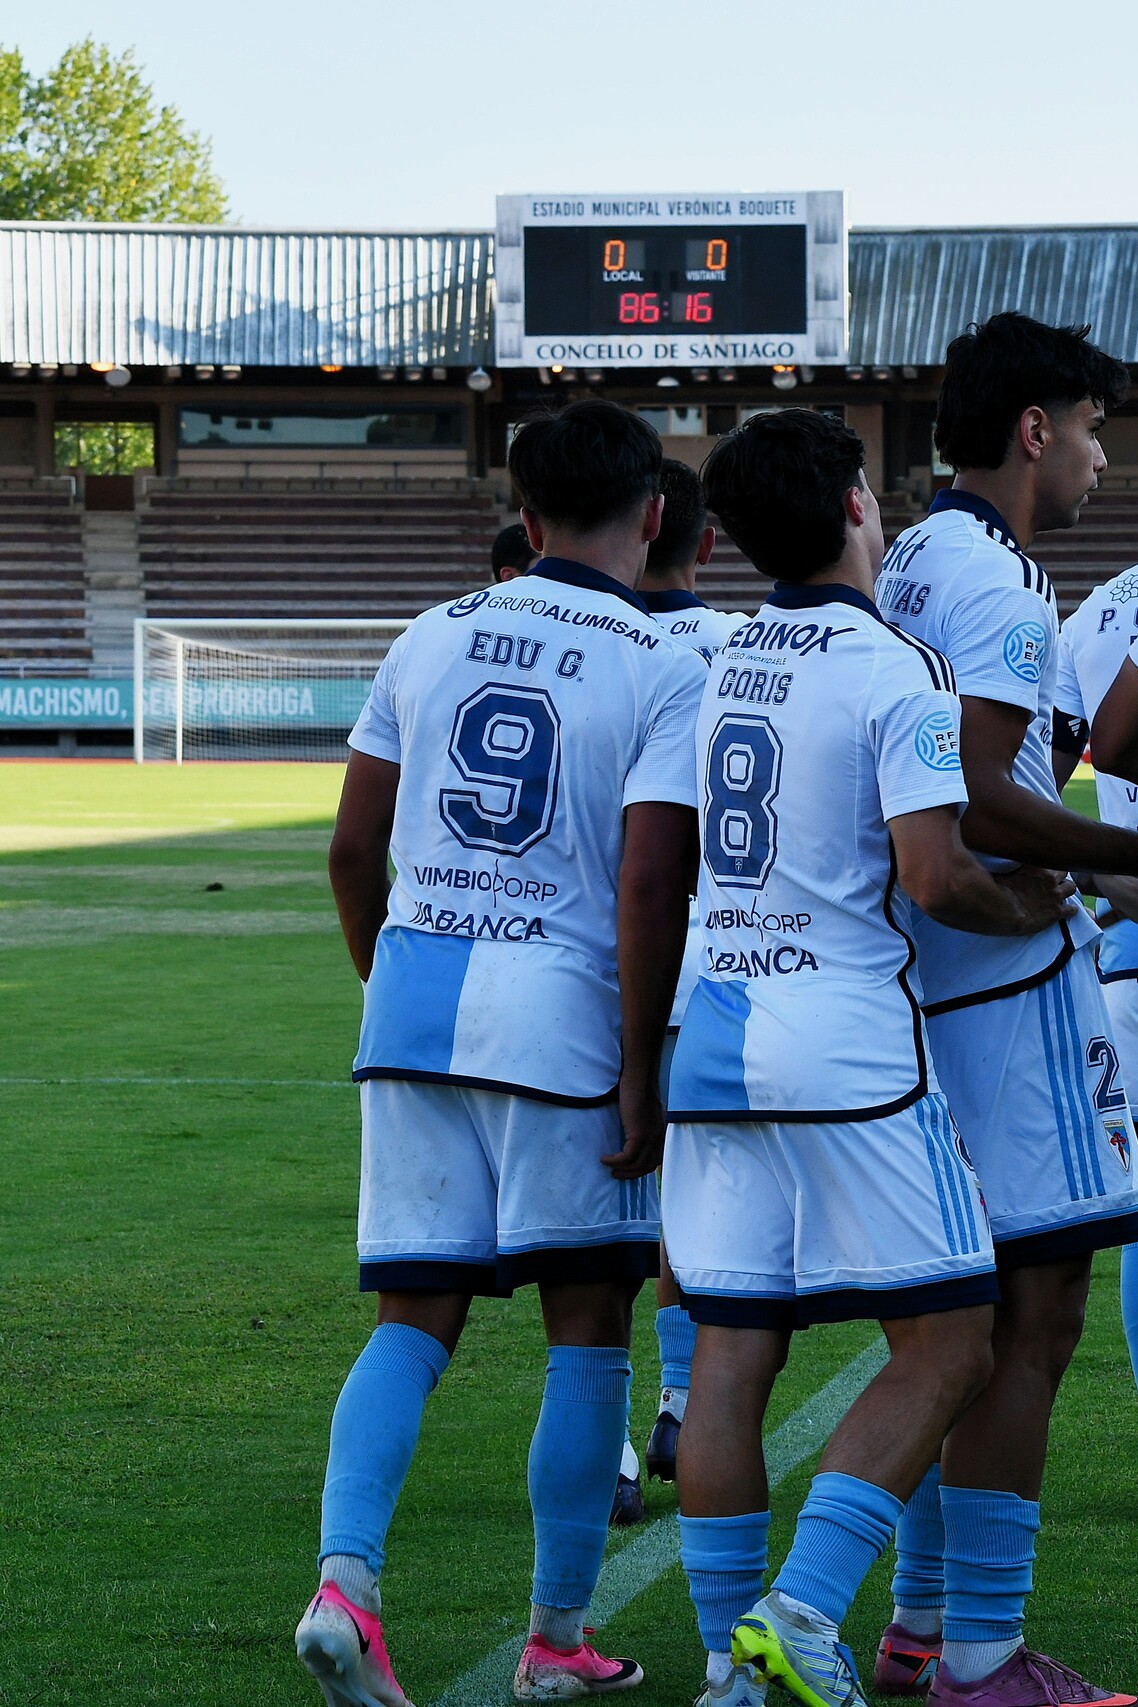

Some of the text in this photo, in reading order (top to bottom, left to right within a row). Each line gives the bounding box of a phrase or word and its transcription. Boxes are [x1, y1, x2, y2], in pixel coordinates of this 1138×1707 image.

[533, 198, 796, 217] ESTADIO MUNICIPAL VERÓNICA BOQUETE
[604, 239, 625, 271] 0
[706, 239, 727, 271] 0
[603, 270, 643, 281] LOCAL
[685, 270, 726, 281] VISITANTE
[537, 342, 794, 360] CONCELLO DE SANTIAGO
[466, 629, 585, 683] EDU G.
[718, 666, 793, 705] GORIS
[439, 681, 561, 859] 9
[703, 712, 784, 890] 8
[414, 861, 557, 905] VIMBIOCORP
[1086, 1036, 1127, 1114] 2
